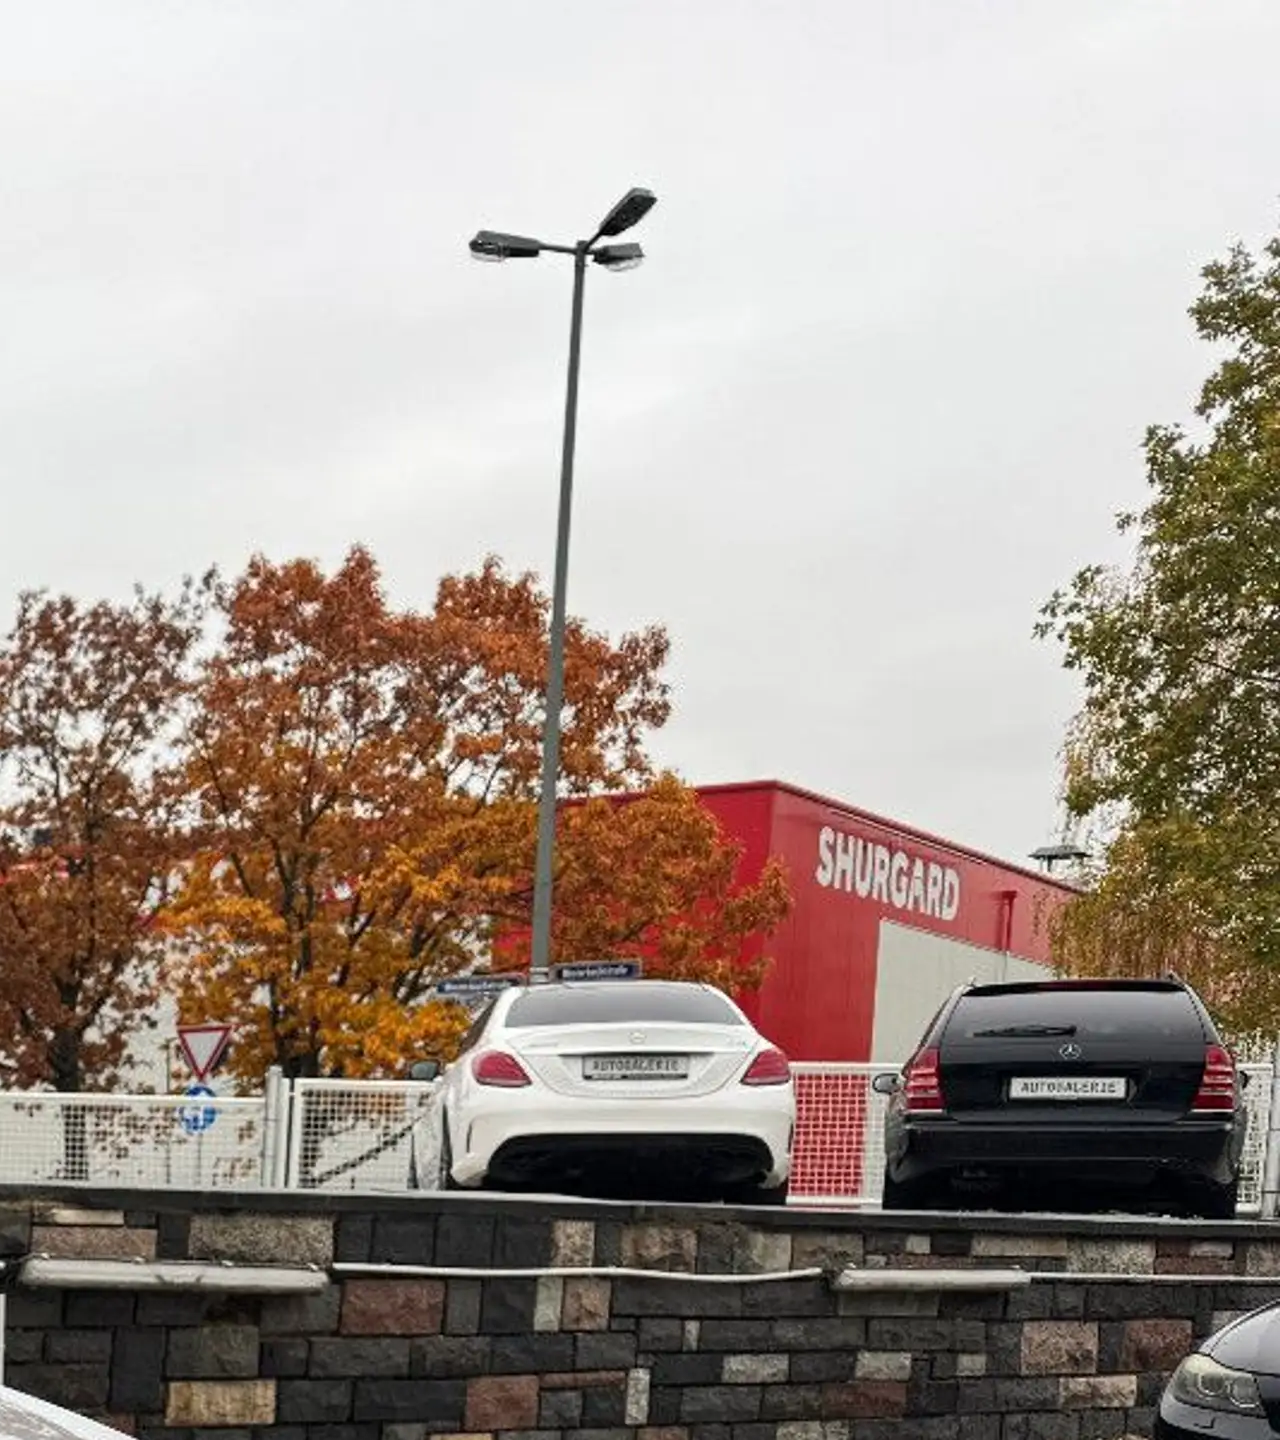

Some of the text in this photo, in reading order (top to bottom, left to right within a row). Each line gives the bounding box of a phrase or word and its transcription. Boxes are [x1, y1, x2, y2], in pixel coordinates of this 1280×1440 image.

[816, 826, 960, 921] SHURGARD
[593, 1057, 681, 1072] AUTOGALERIE
[1020, 1081, 1117, 1094] AUTOGALERIE
